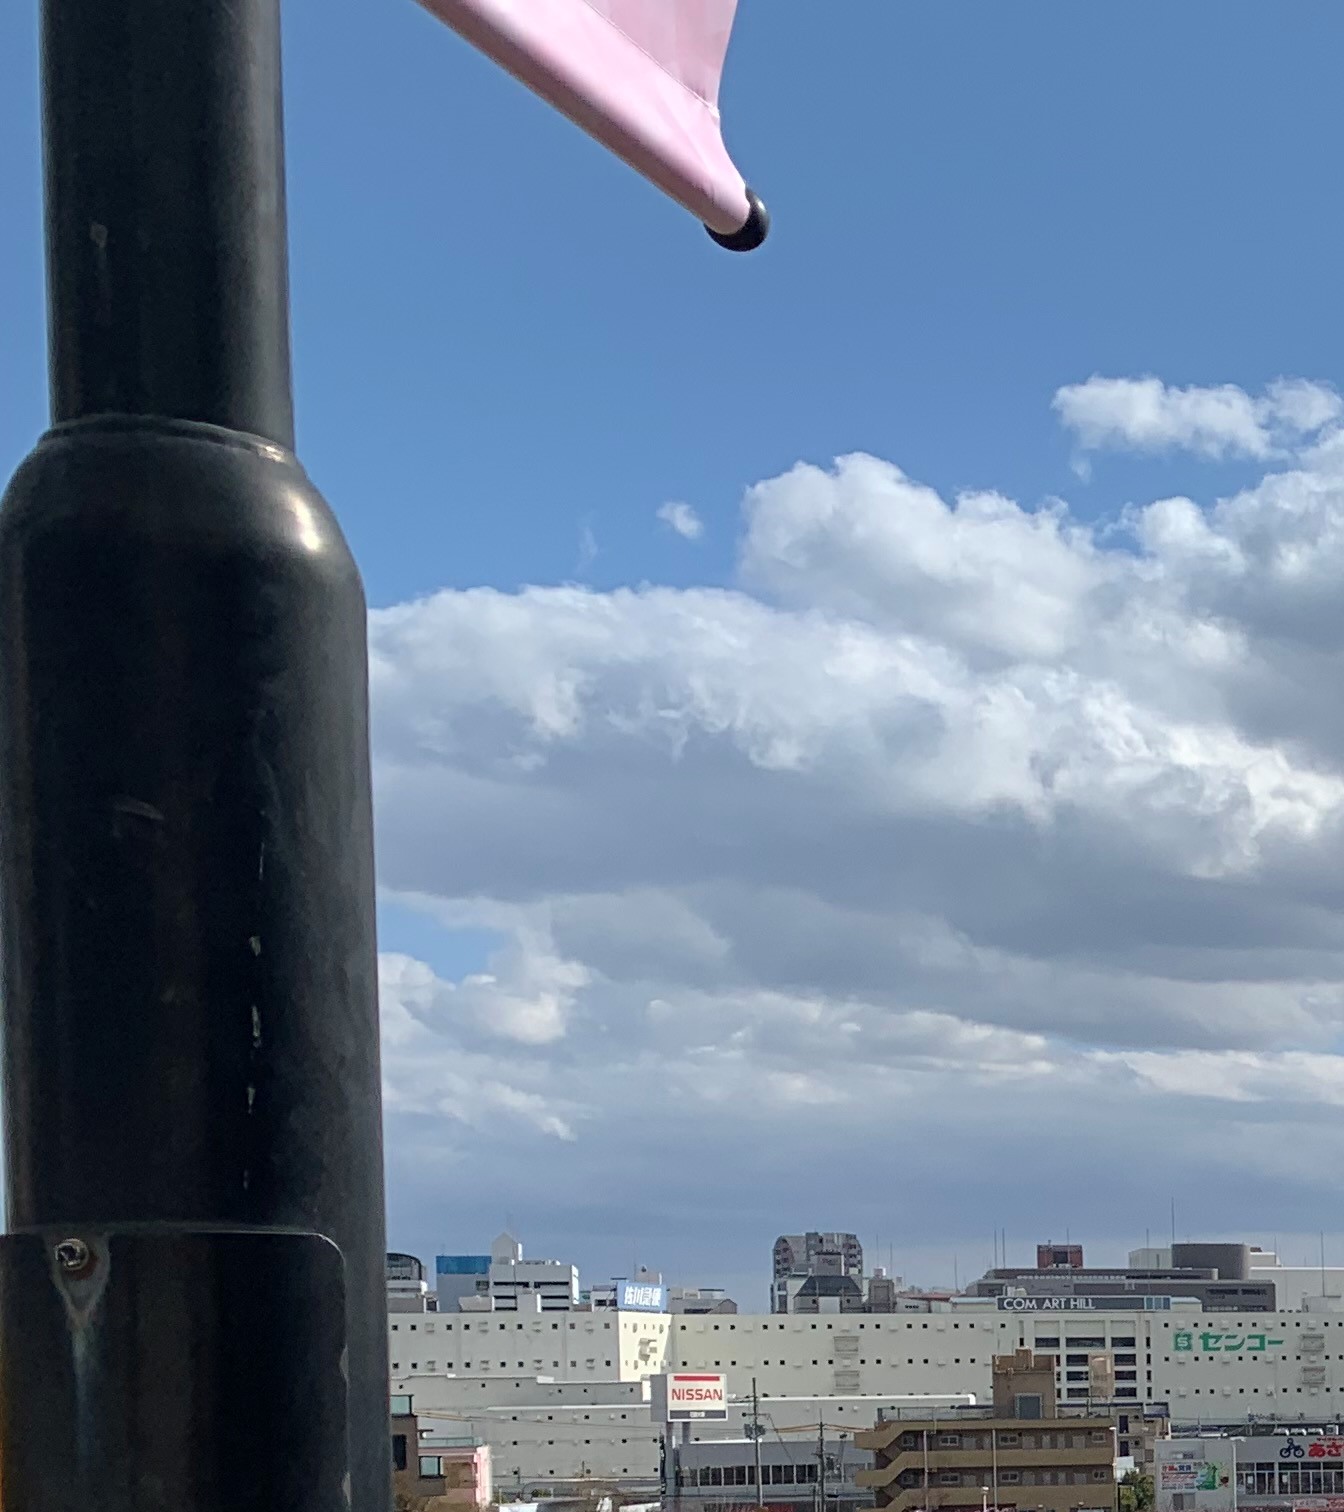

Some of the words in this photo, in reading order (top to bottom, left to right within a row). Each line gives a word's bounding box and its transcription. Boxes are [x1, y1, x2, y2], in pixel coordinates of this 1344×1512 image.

[624, 1286, 662, 1306] 佐川急便
[1003, 1299, 1037, 1309] COM
[1042, 1299, 1067, 1309] ART
[1071, 1299, 1096, 1309] HILL
[1199, 1332, 1284, 1351] センコー
[671, 1388, 723, 1400] NISSAN
